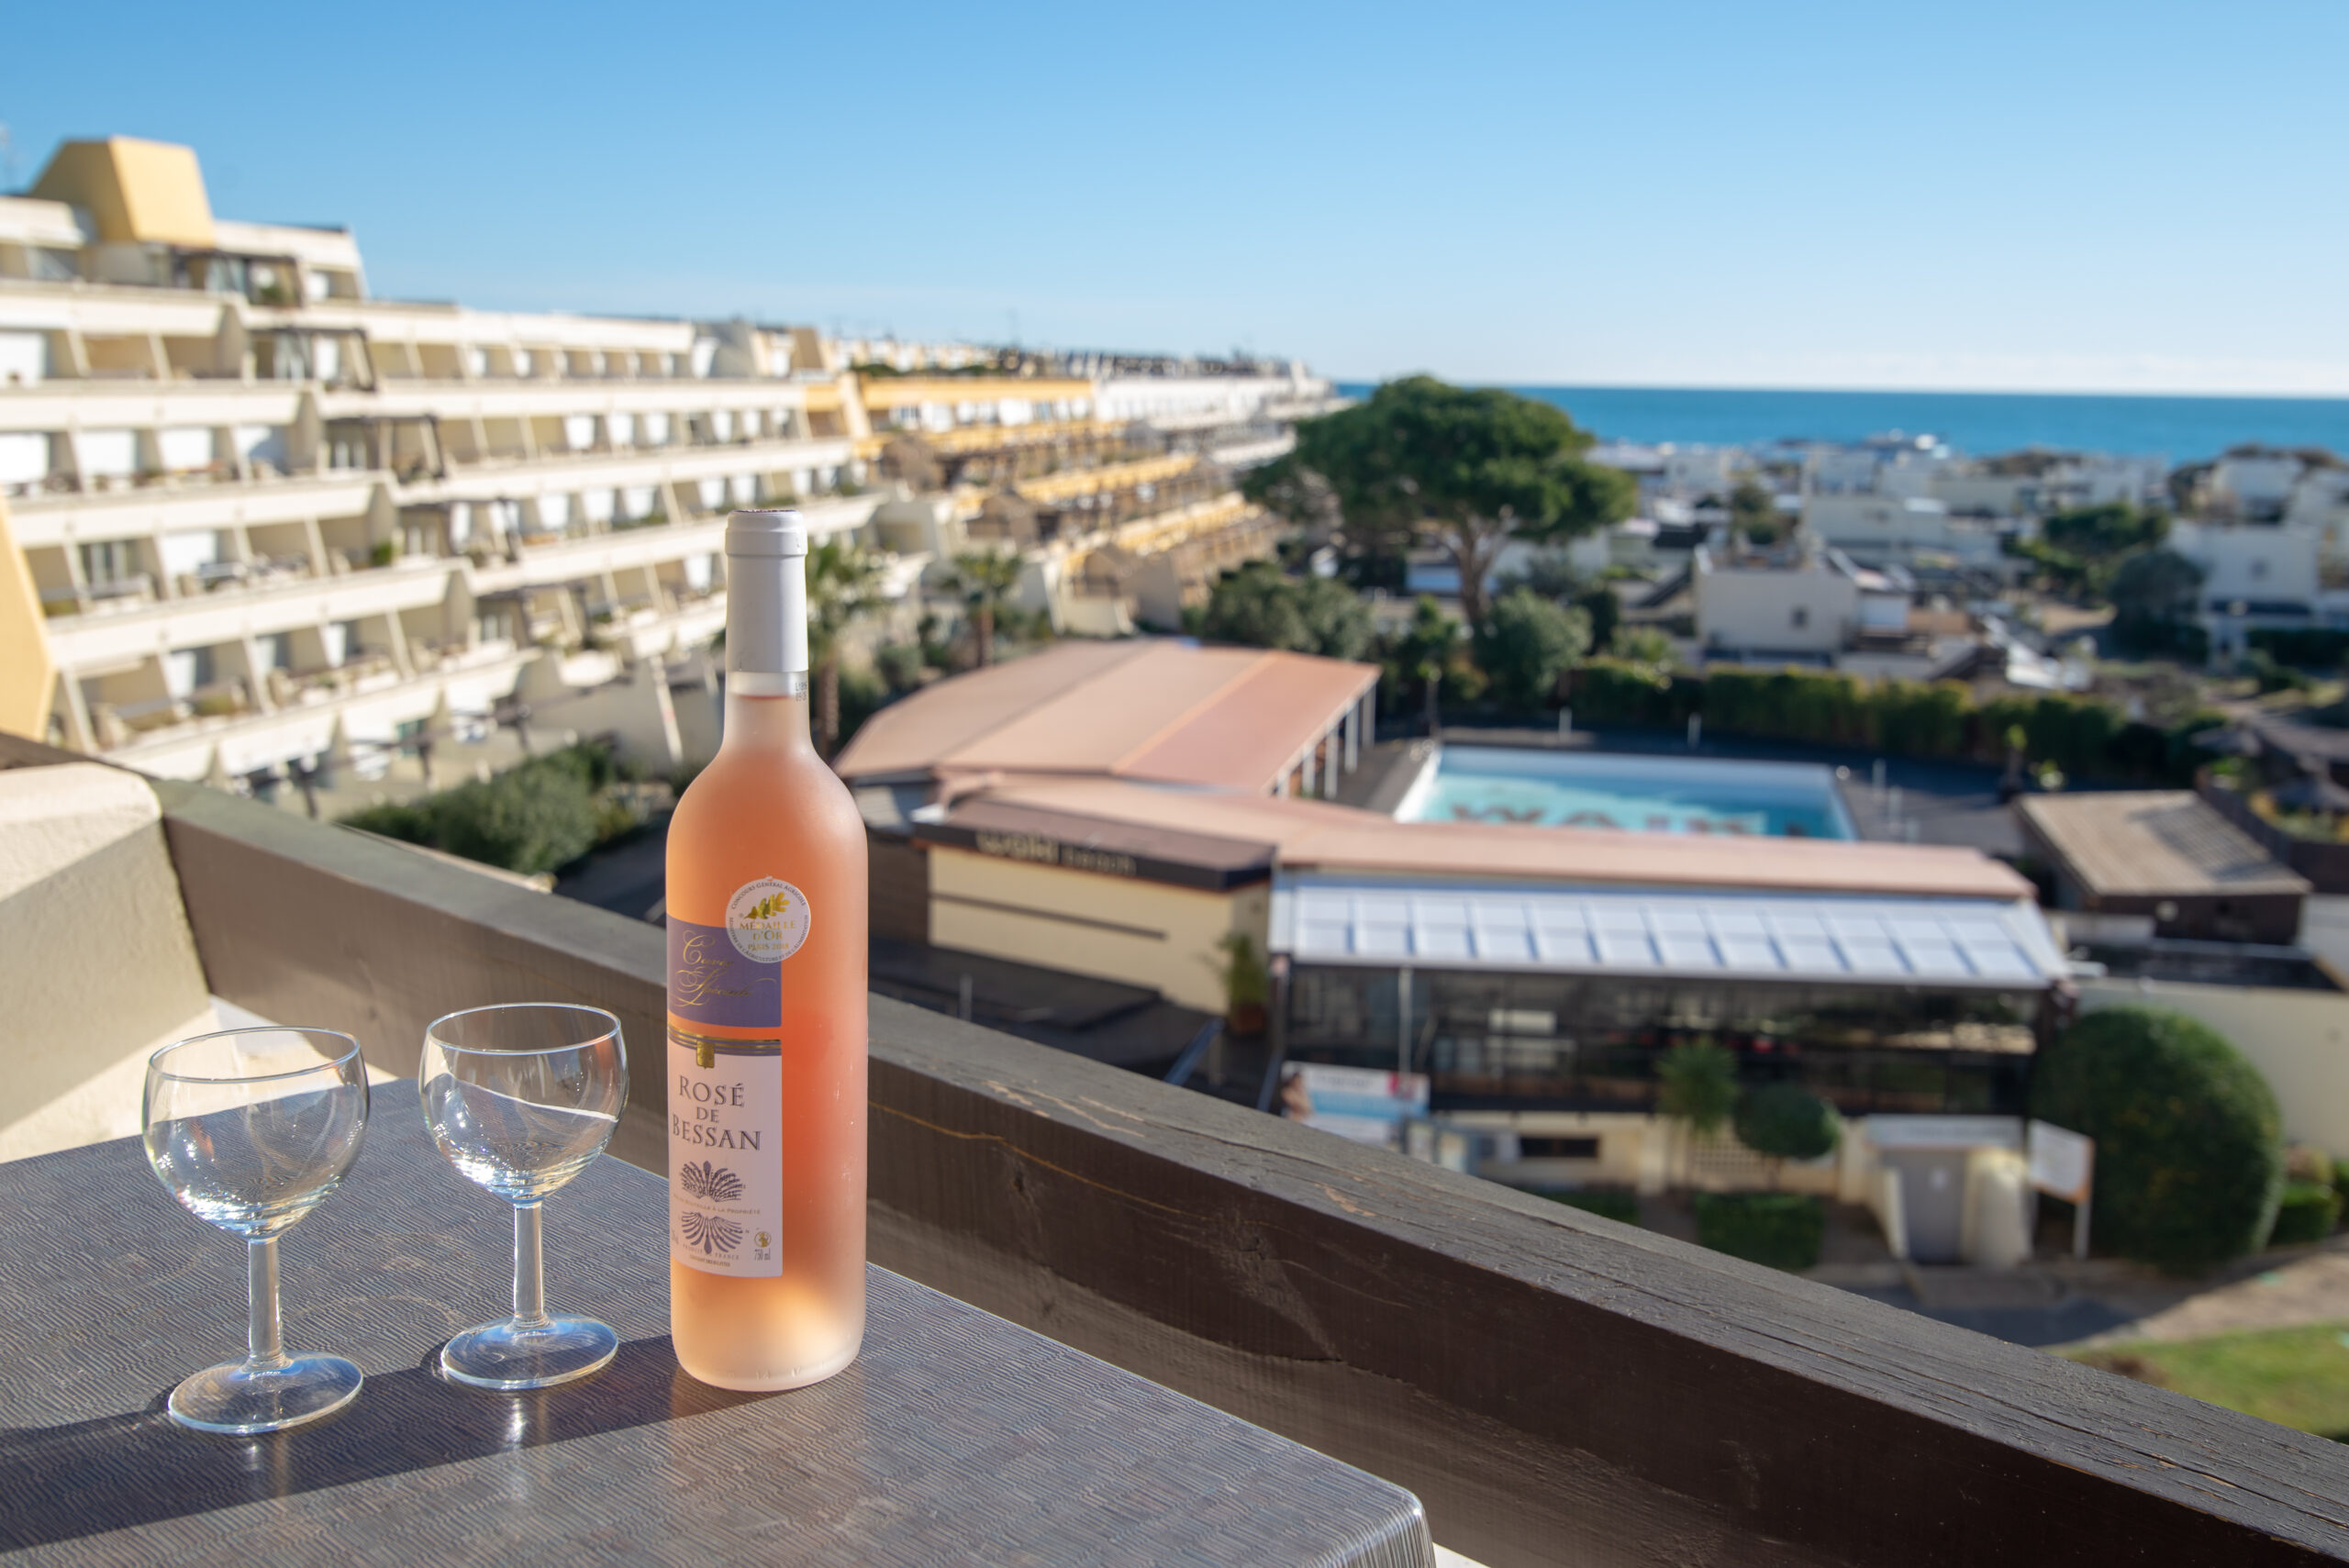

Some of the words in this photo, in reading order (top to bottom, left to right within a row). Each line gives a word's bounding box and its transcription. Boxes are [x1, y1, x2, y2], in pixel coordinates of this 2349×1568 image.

[739, 919, 796, 930] MÉDAILLE
[679, 1074, 744, 1107] ROSÉ
[696, 1106, 719, 1123] DE
[673, 1113, 763, 1151] BESSAN
